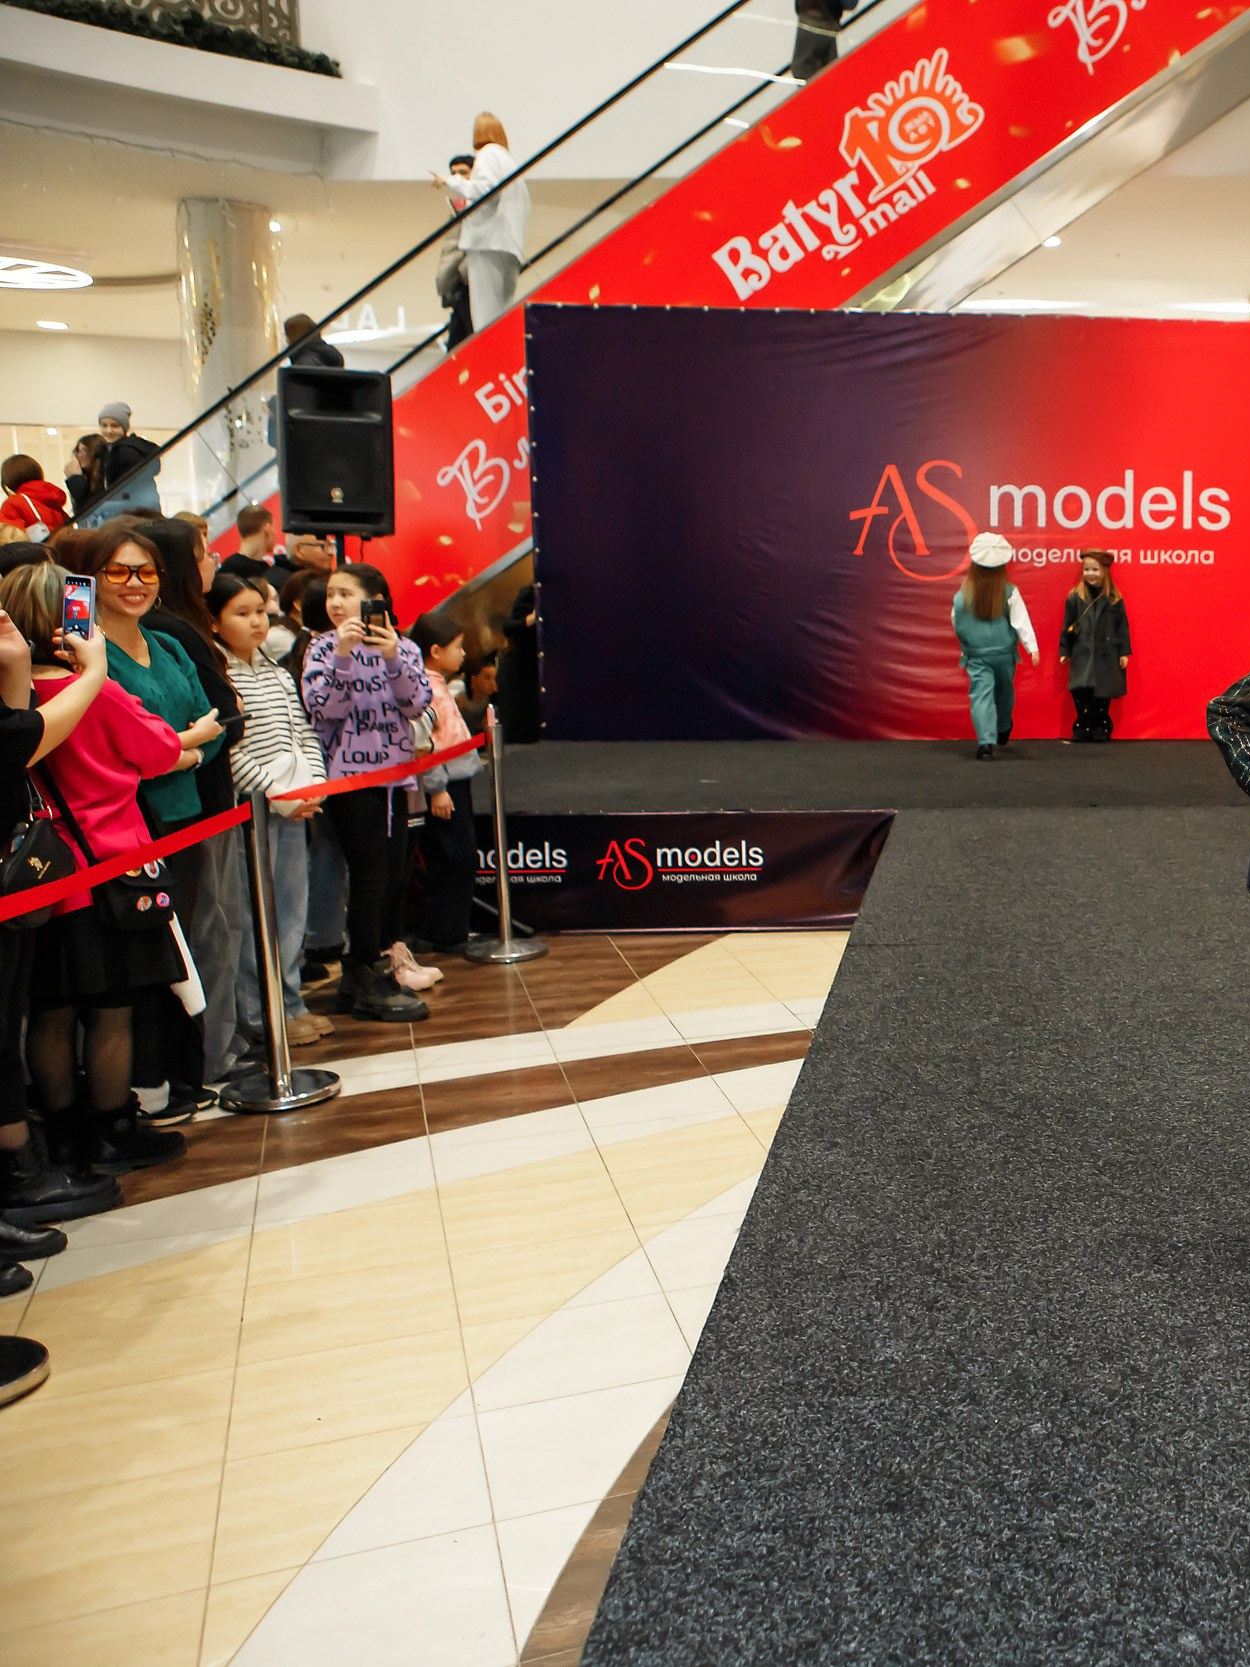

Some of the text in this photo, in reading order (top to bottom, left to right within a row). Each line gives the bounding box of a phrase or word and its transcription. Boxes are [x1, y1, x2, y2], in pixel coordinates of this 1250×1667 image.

[858, 169, 937, 238] mall
[711, 170, 867, 301] Batyr
[849, 459, 1232, 582] AS models
[1140, 550, 1215, 565] школа
[527, 875, 562, 883] школа
[596, 838, 764, 891] AS models
[662, 873, 757, 883] модельная школа
